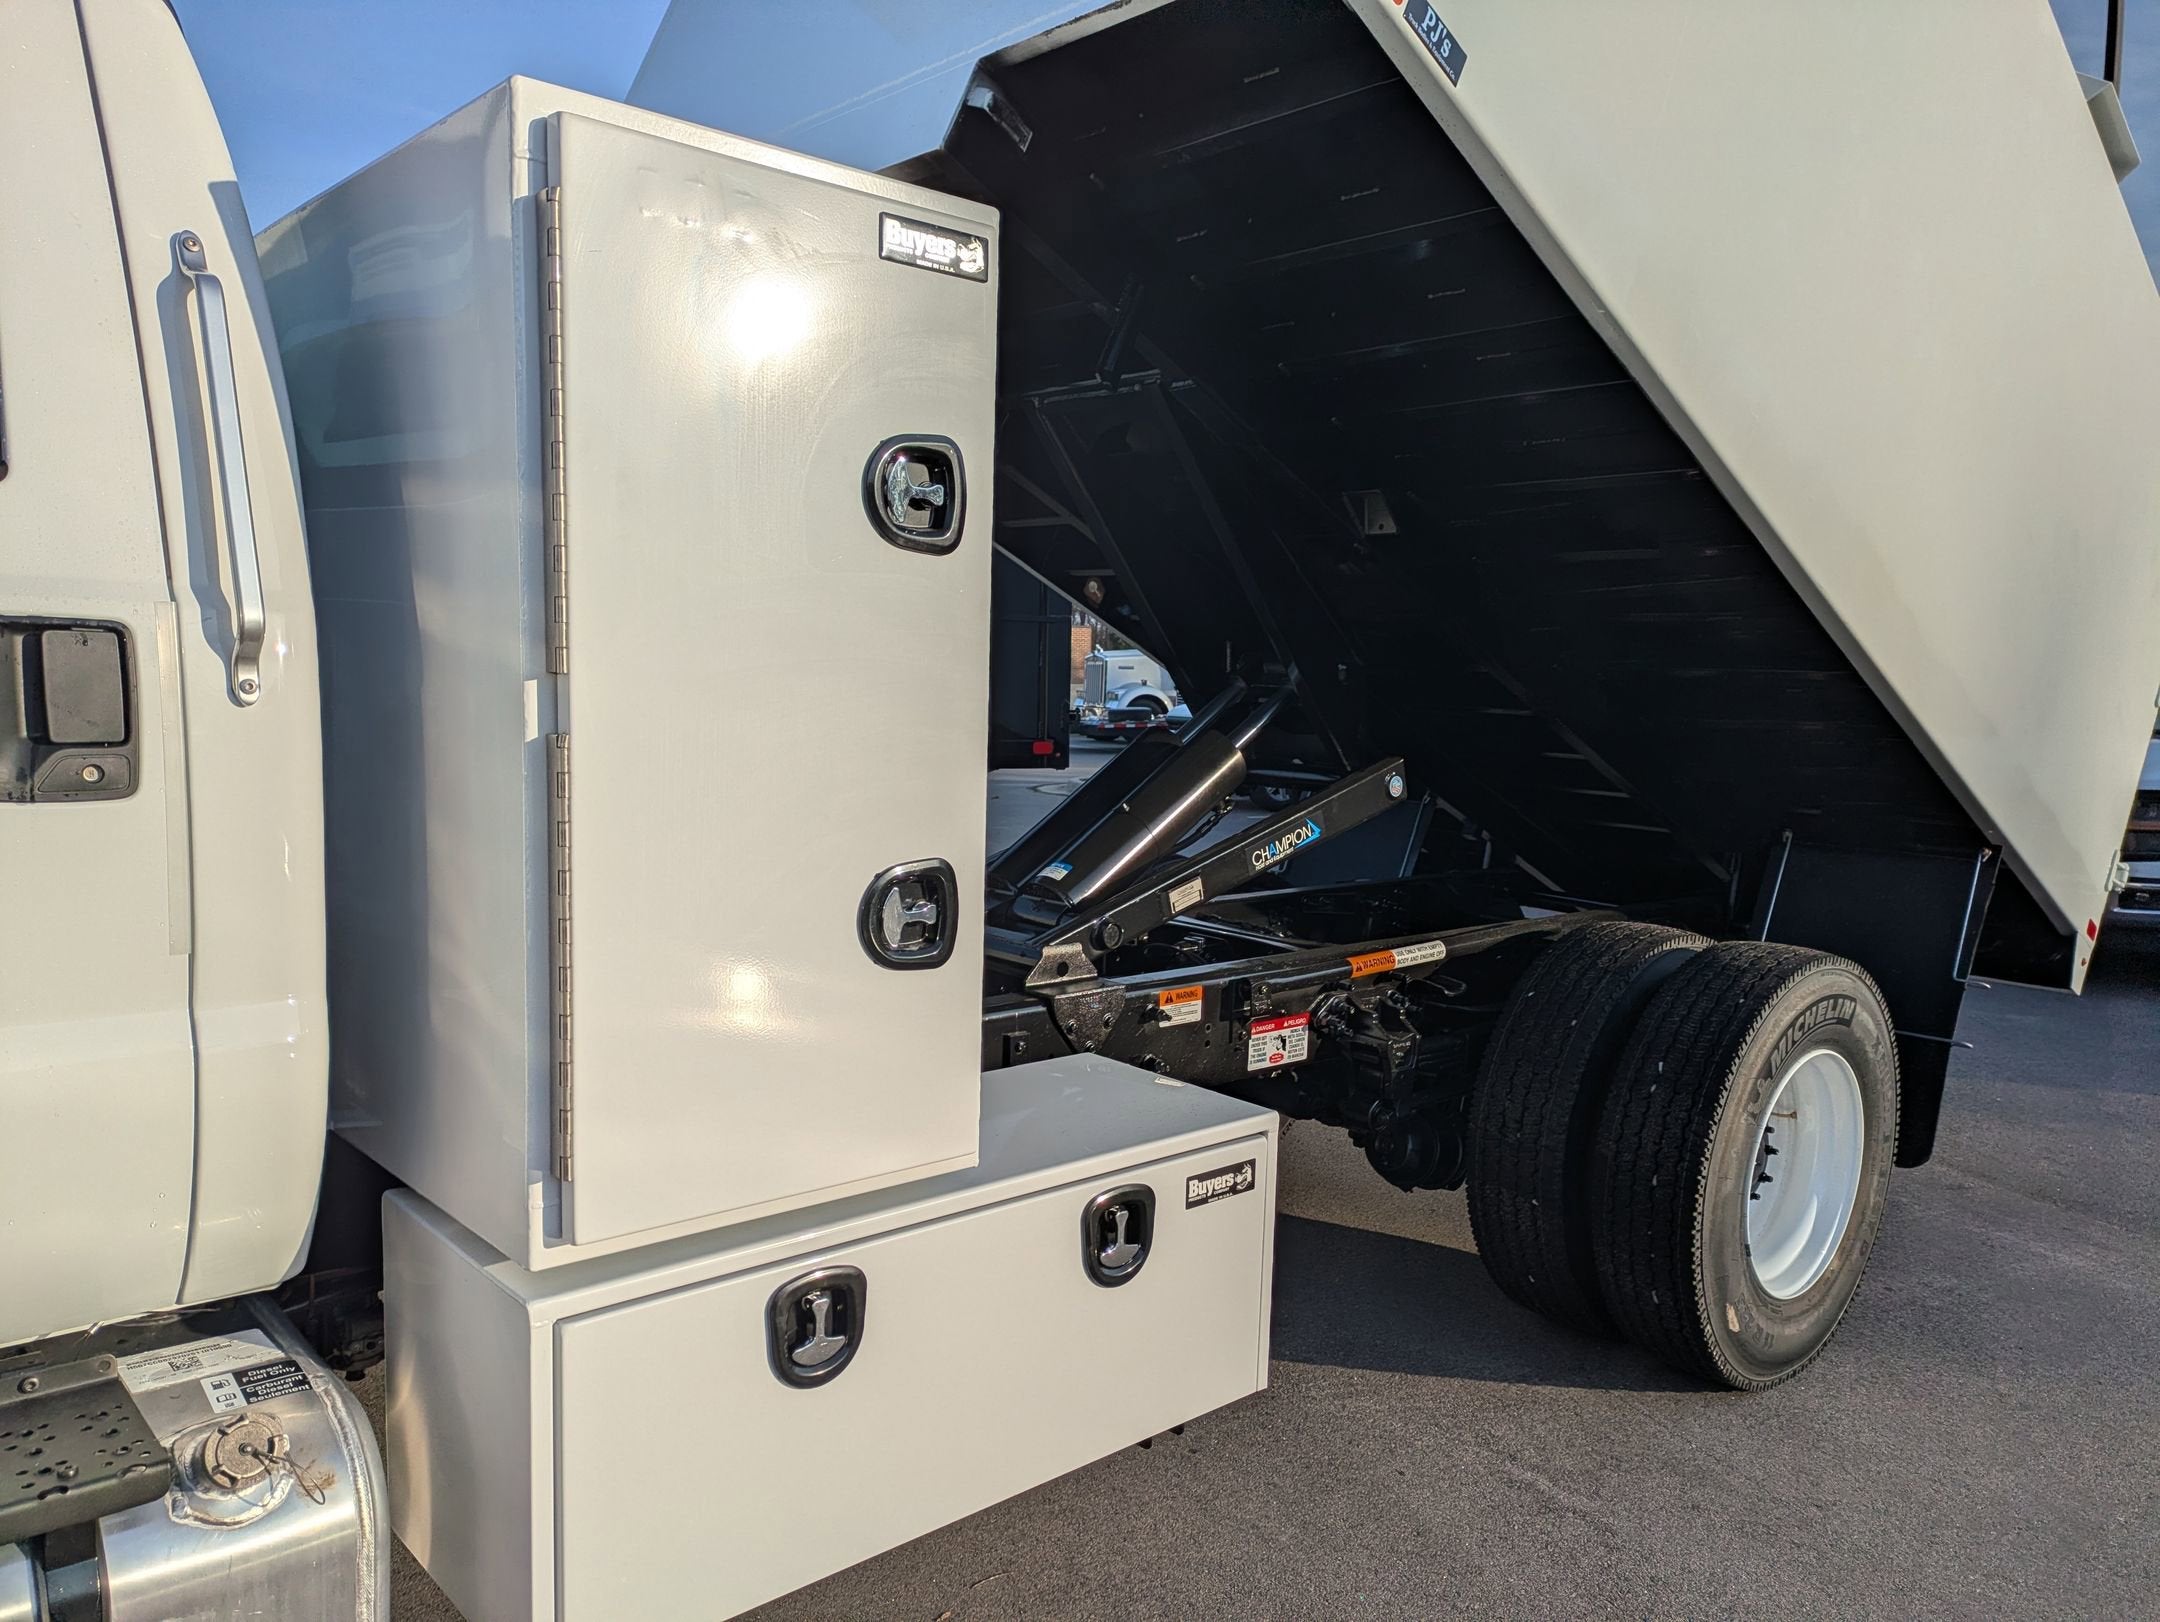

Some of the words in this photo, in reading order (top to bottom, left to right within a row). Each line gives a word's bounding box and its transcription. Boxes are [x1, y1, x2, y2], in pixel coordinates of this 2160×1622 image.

[1421, 6, 1452, 58] PJ's
[885, 218, 957, 259] Buyers
[1252, 824, 1312, 866] CHAMPION
[1362, 955, 1396, 970] WARNING
[1175, 990, 1199, 1000] WARNING
[1256, 1023, 1276, 1032] DANGER
[1770, 998, 1856, 1077] MICHELIN
[1188, 1173, 1235, 1198] Buyers
[242, 1373, 267, 1383] Fuel
[269, 1366, 296, 1376] Only
[247, 1364, 282, 1377] Diesel
[246, 1374, 303, 1393] Carburant
[258, 1382, 293, 1395] Diesel
[249, 1384, 311, 1403] Seulement
